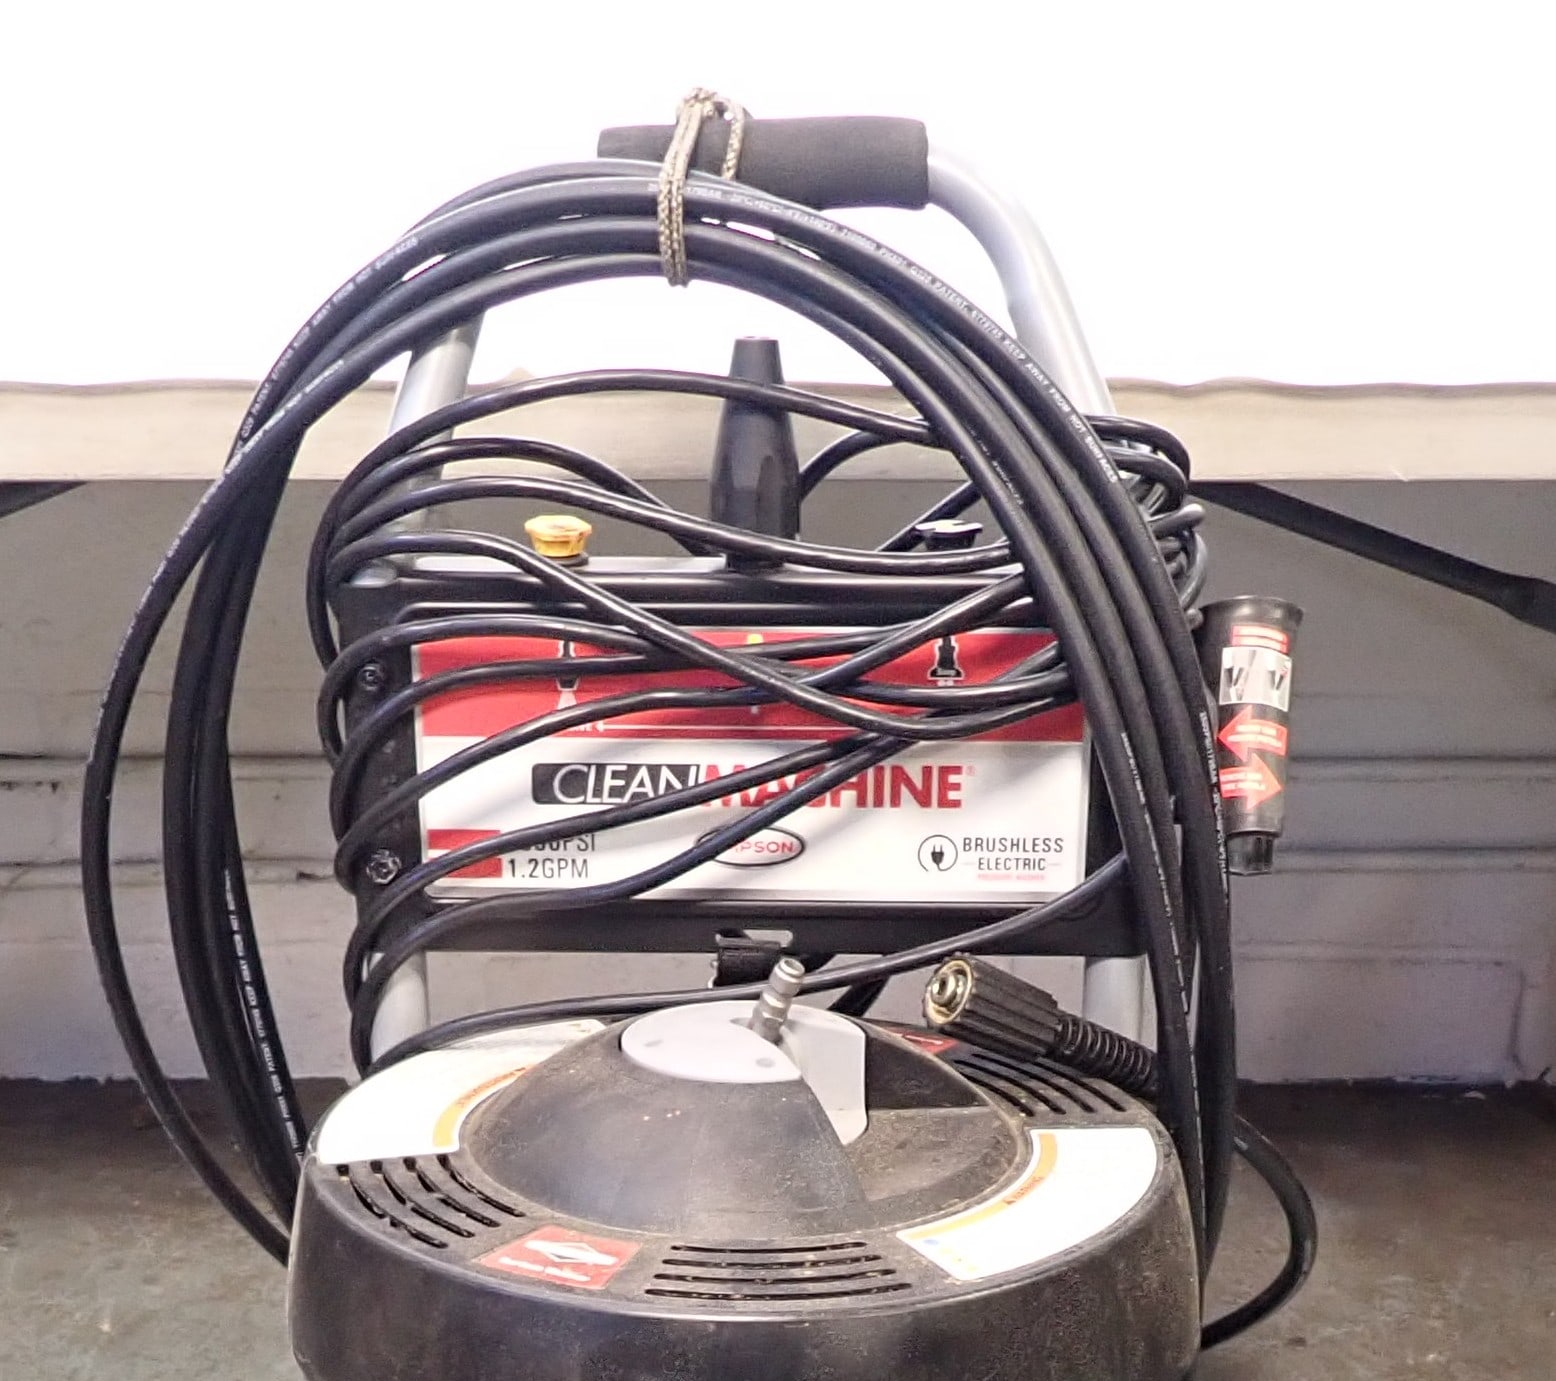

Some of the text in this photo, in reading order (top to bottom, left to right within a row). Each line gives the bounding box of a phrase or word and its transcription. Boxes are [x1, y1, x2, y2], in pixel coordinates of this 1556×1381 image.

[962, 837, 1064, 853] BRUSHLESS
[508, 858, 588, 878] 1.2GPM
[977, 857, 1046, 871] ELECTRIC
